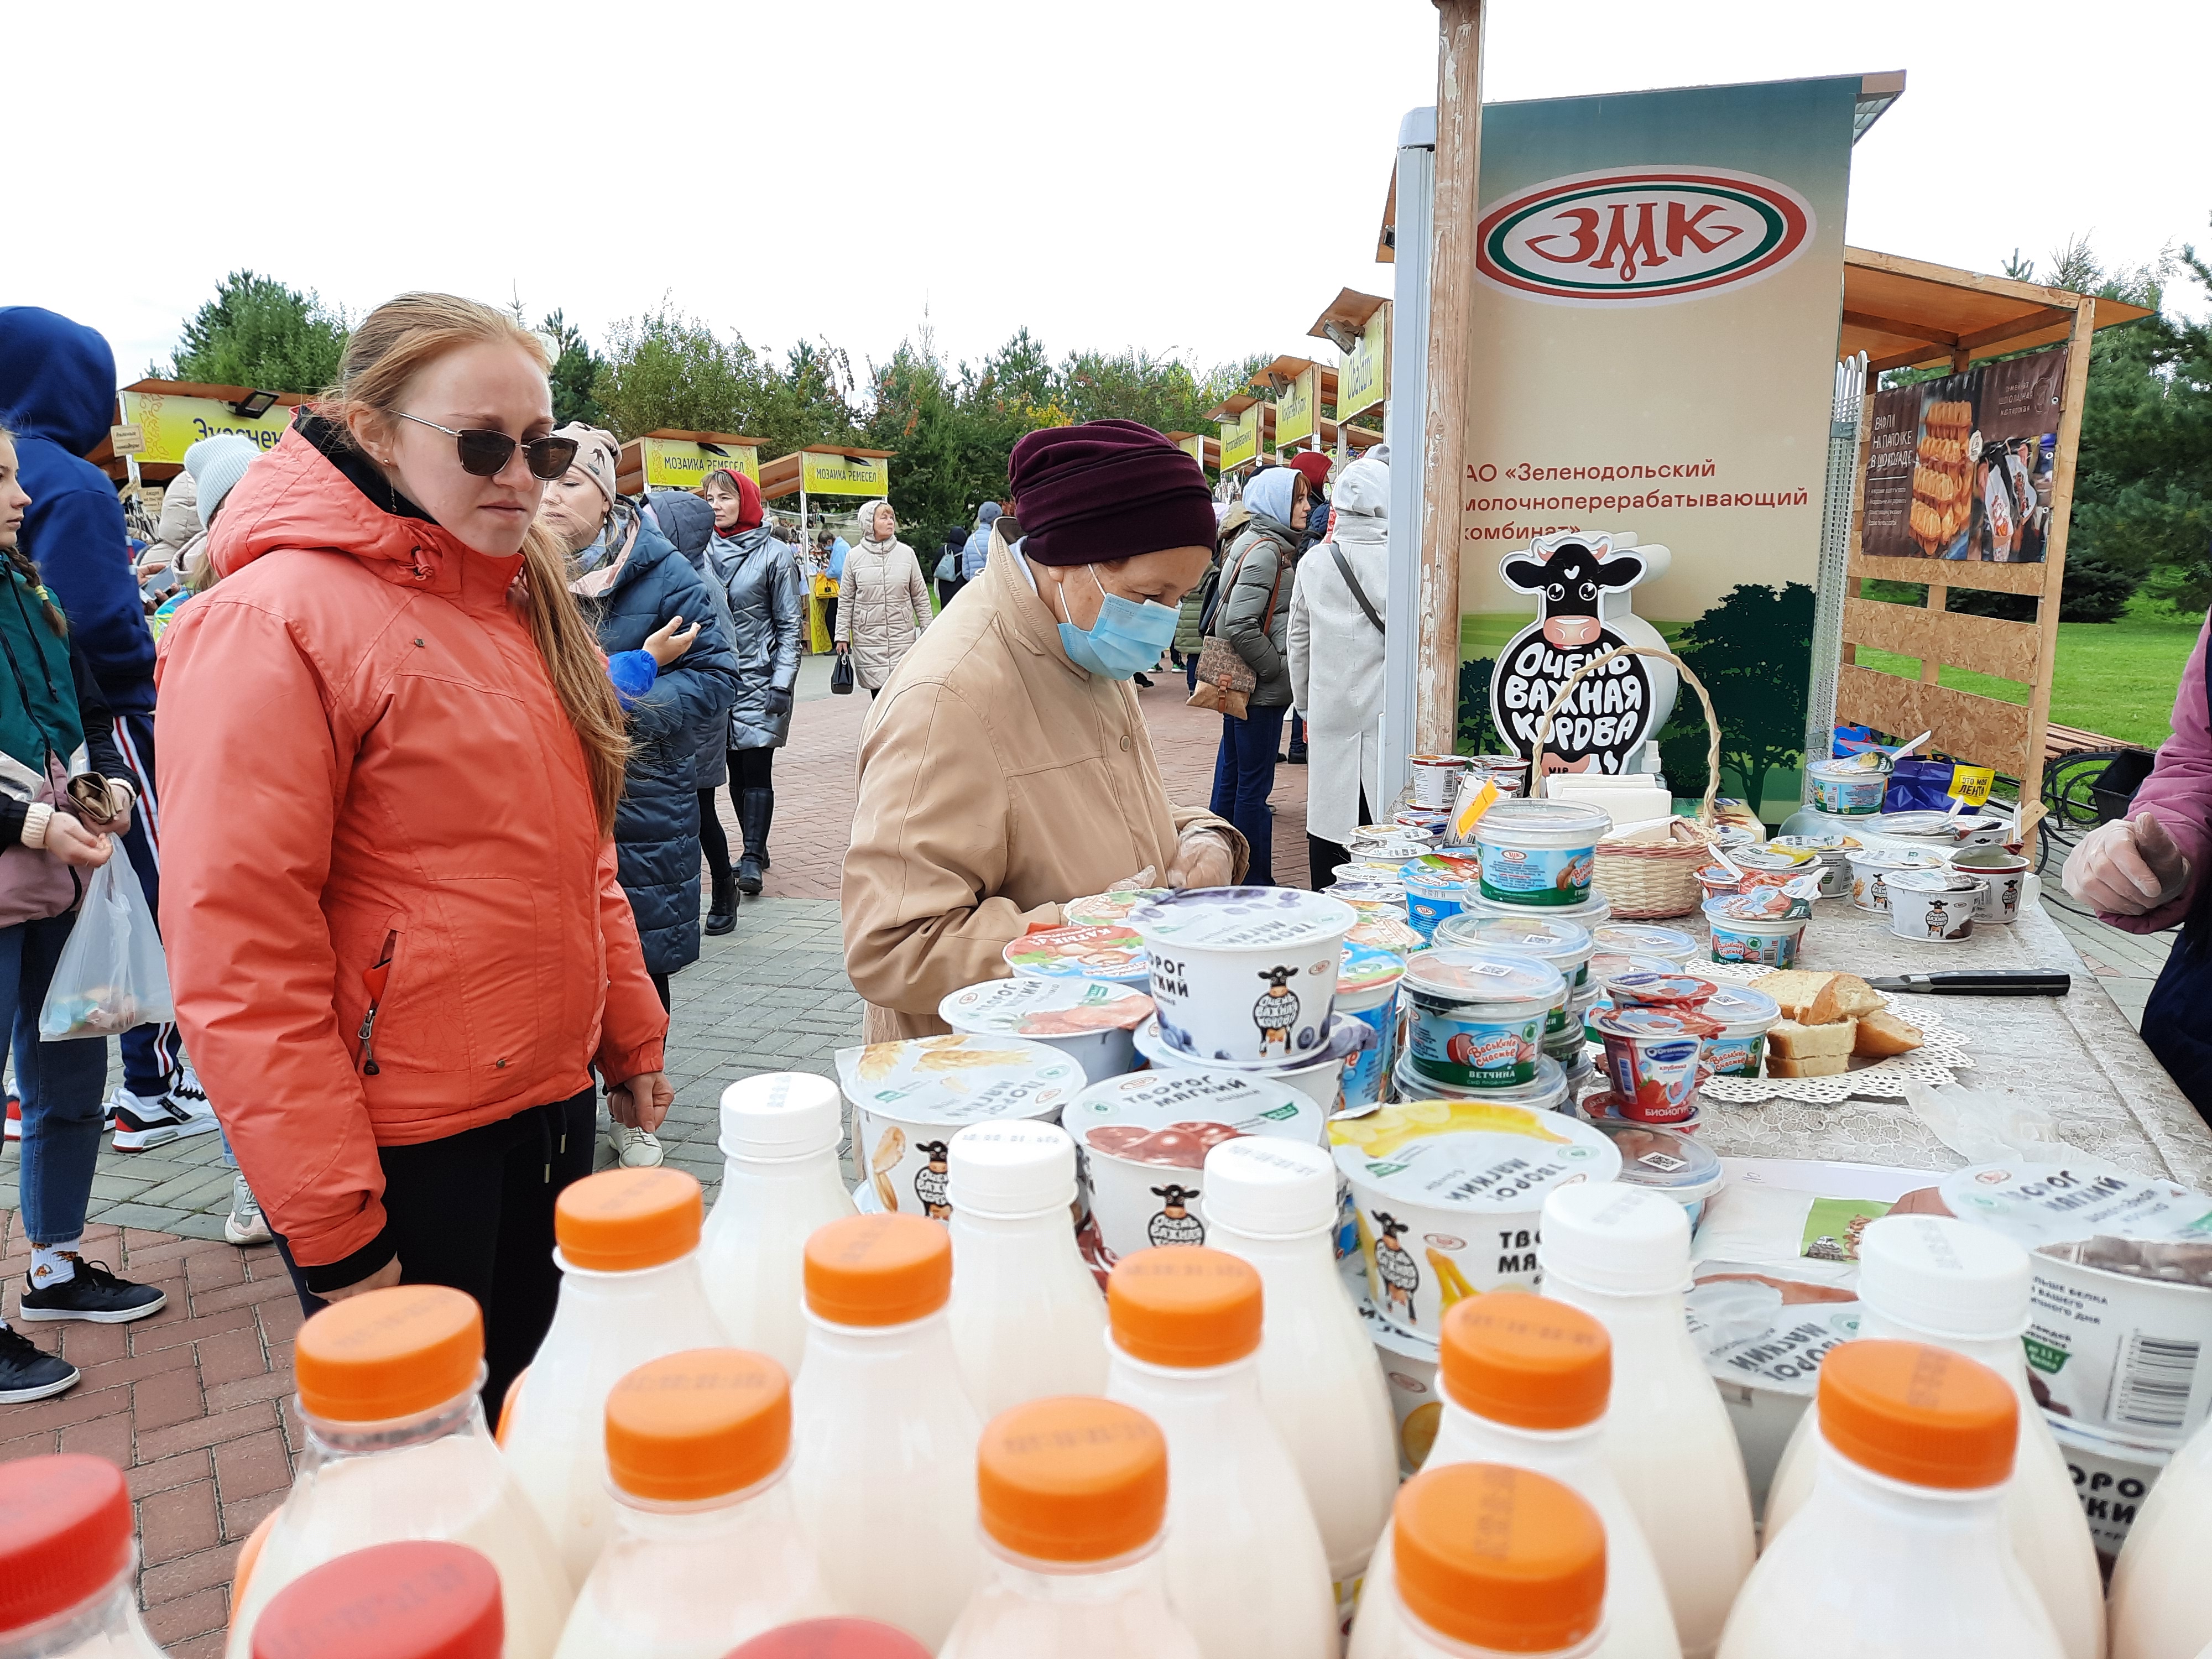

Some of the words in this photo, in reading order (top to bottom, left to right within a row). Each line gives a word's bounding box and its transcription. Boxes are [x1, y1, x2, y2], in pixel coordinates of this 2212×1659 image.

[1525, 201, 1745, 282] ЗМК
[1875, 414, 1896, 430] ВАФЛИ
[664, 456, 705, 471] МОЗАИКА
[1504, 458, 1716, 482] «Зеленодольский
[1870, 454, 1876, 468] В
[816, 468, 846, 481] МОЗАИКА
[848, 470, 877, 483] РЕМЕСЕЛ
[1465, 488, 1809, 514] молочноперерабатывающий
[1515, 642, 1631, 679] ОЧЕНЬ
[1505, 674, 1642, 716] ВАЖНАЯ
[1511, 711, 1639, 751] КОРОВА
[1958, 784, 1985, 796] ЛЕНТА
[1469, 1039, 1517, 1059] Васькино
[1469, 1070, 1516, 1079] ВЕТЧИНА
[1121, 1073, 1212, 1105] ТВОРОГ
[1154, 1076, 1249, 1108] МЯГКИЙ
[1443, 1156, 1530, 1203] МЯГКИЙ
[1727, 1321, 1829, 1375] МЯГКИЙ
